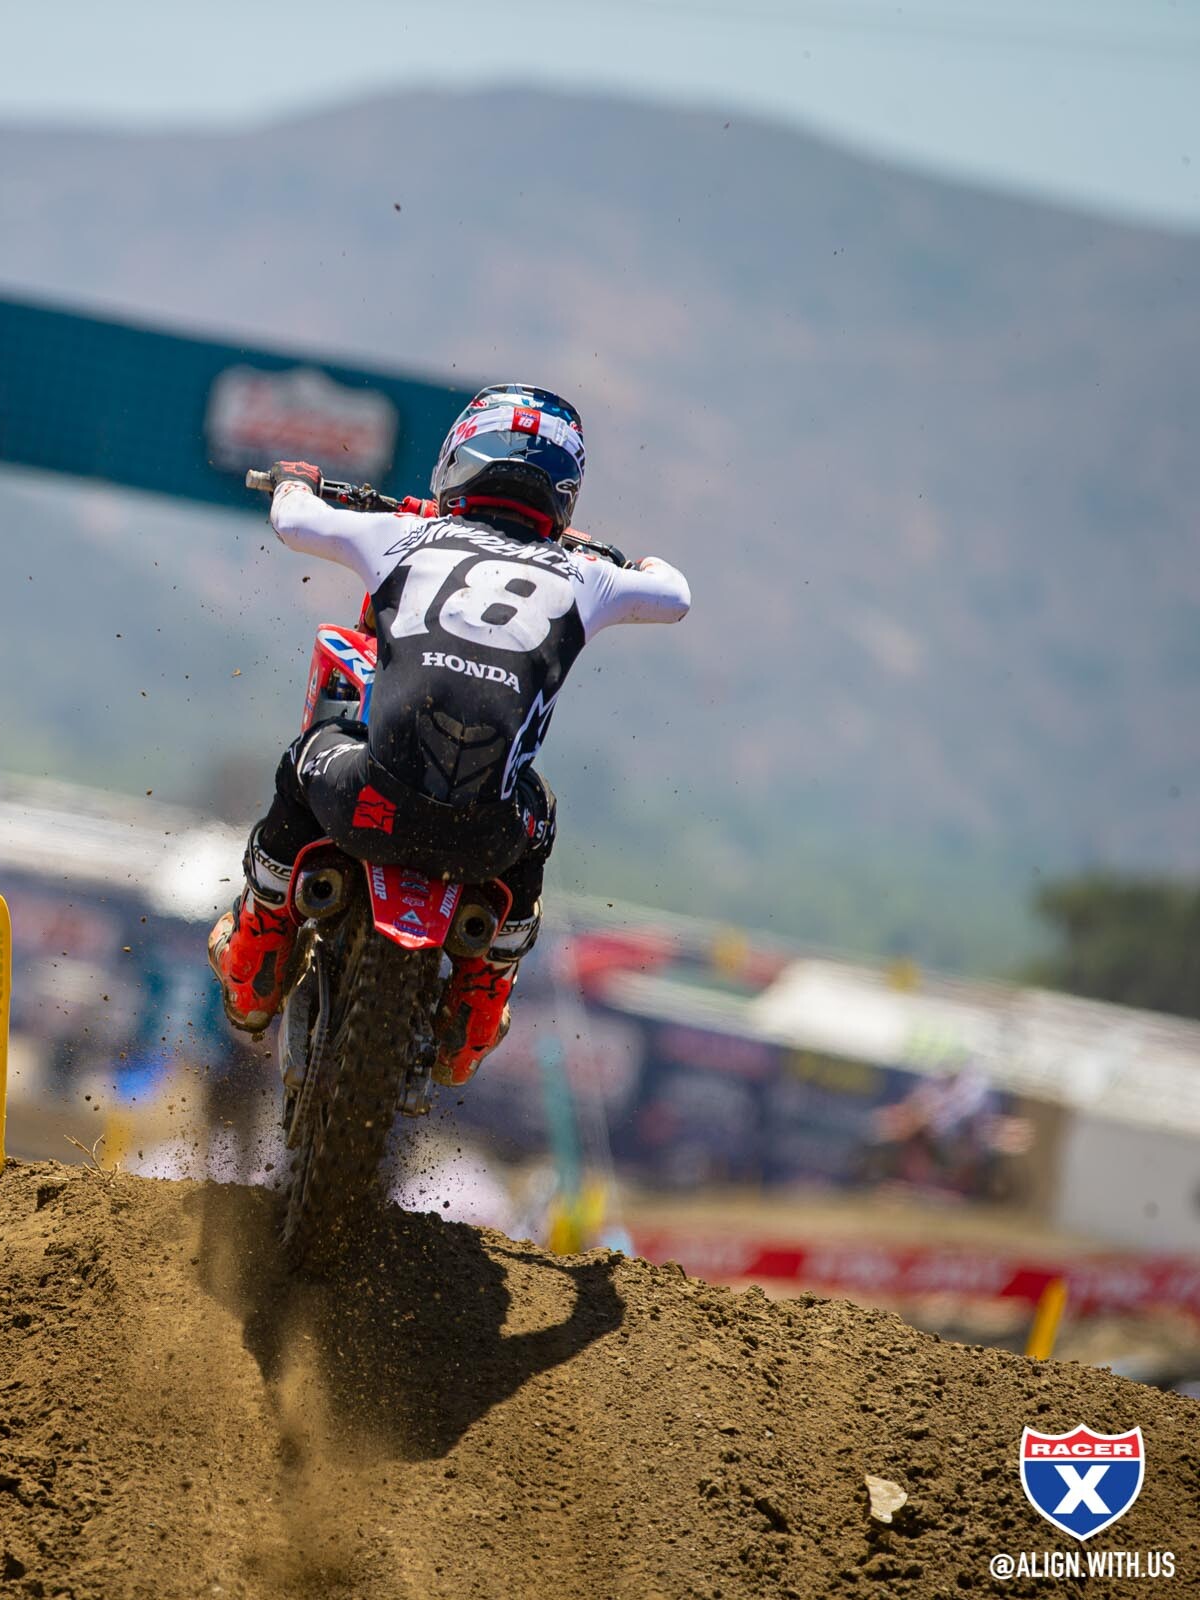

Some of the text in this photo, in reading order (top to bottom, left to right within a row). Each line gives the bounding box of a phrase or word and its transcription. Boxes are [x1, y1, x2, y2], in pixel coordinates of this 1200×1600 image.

[390, 547, 576, 653] 18
[421, 651, 521, 694] HONDA
[371, 865, 388, 901] NLOP
[439, 883, 460, 919] DUNL
